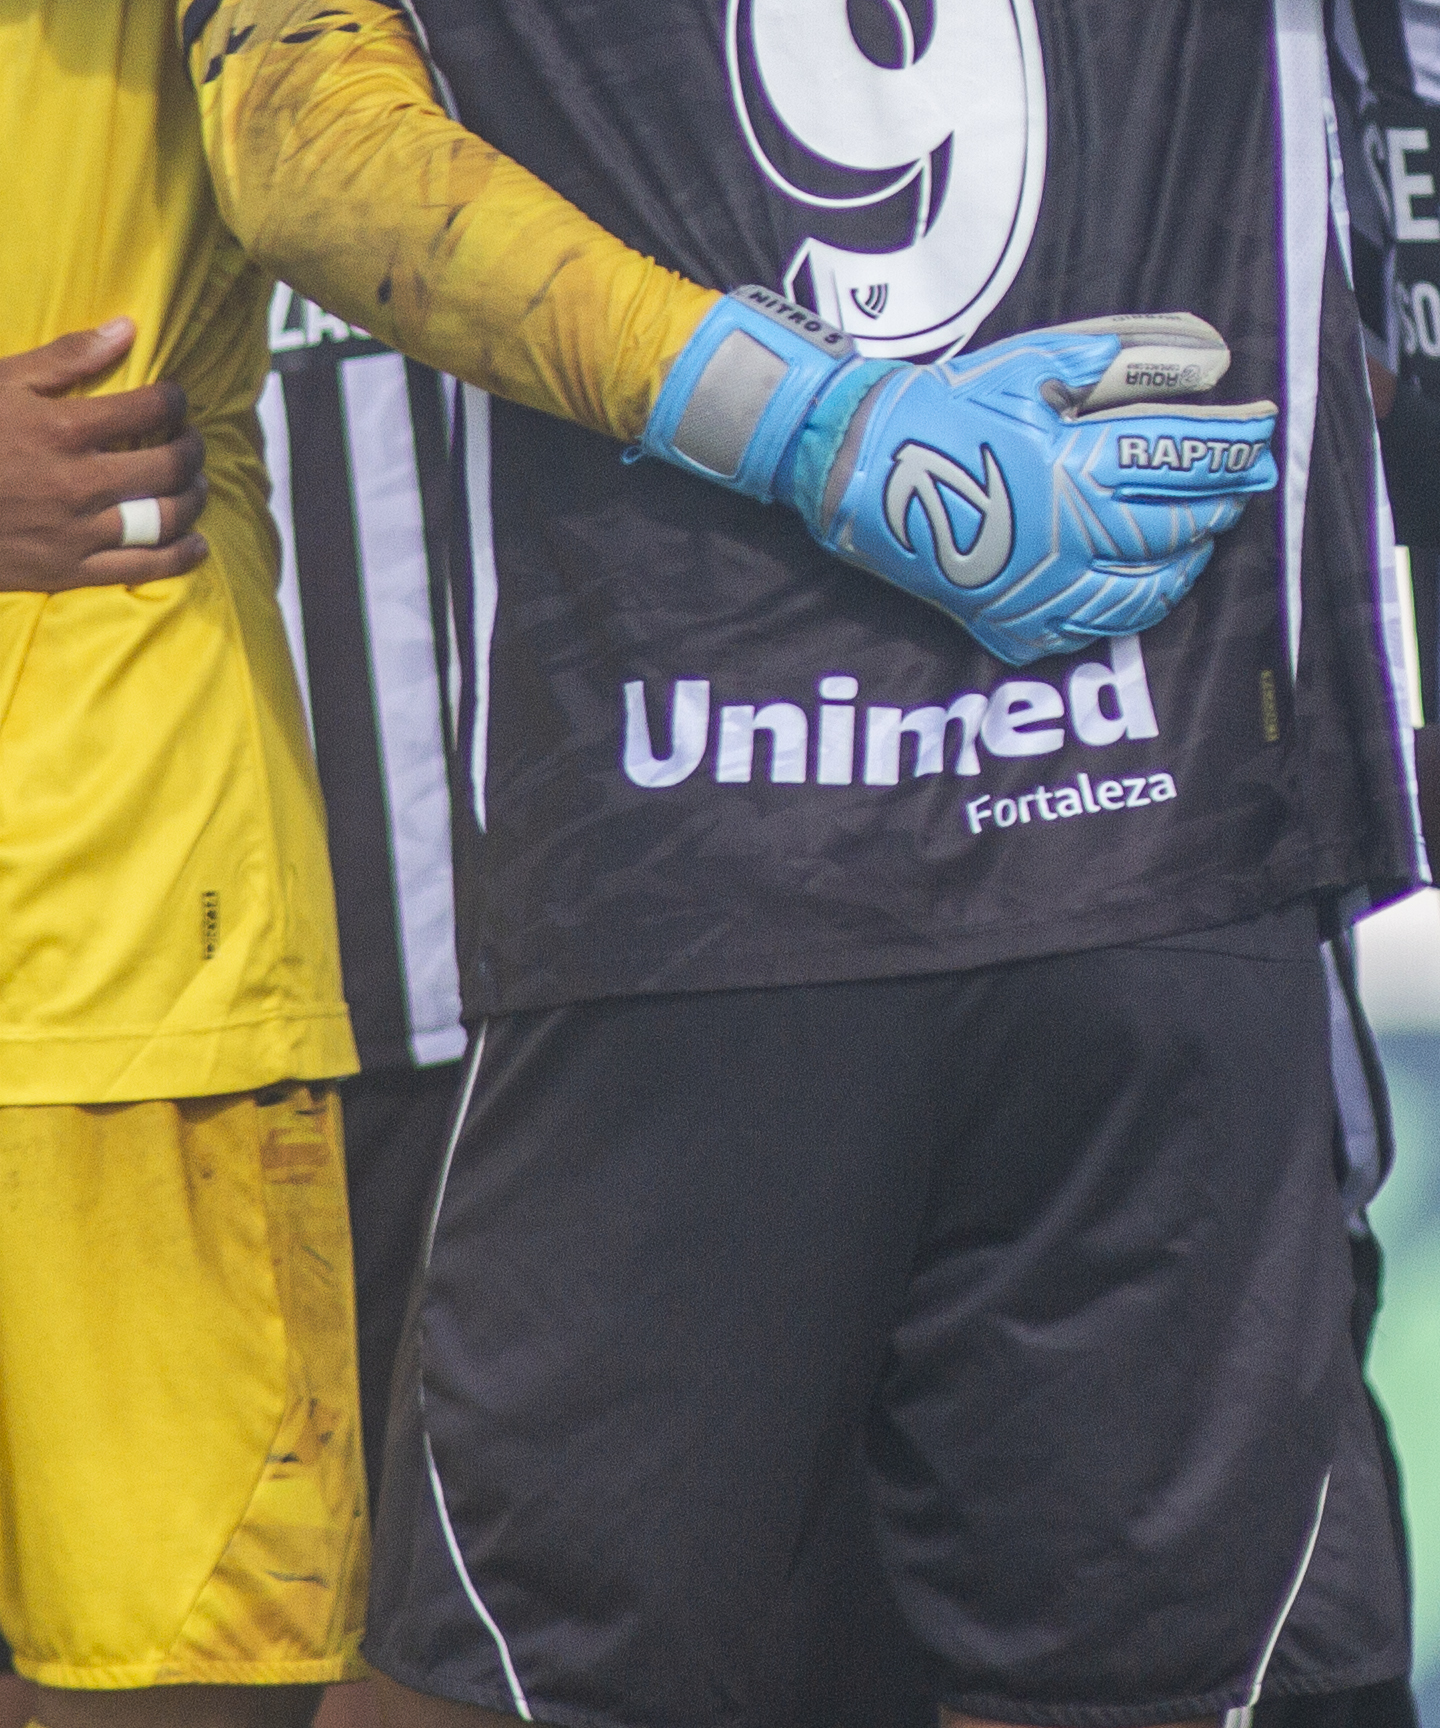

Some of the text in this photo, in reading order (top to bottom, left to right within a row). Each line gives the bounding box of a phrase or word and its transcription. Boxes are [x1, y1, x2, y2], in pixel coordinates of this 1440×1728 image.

[749, 291, 821, 332] NITRO
[622, 633, 1158, 788] Unimed
[966, 767, 1177, 835] Fortaleza
